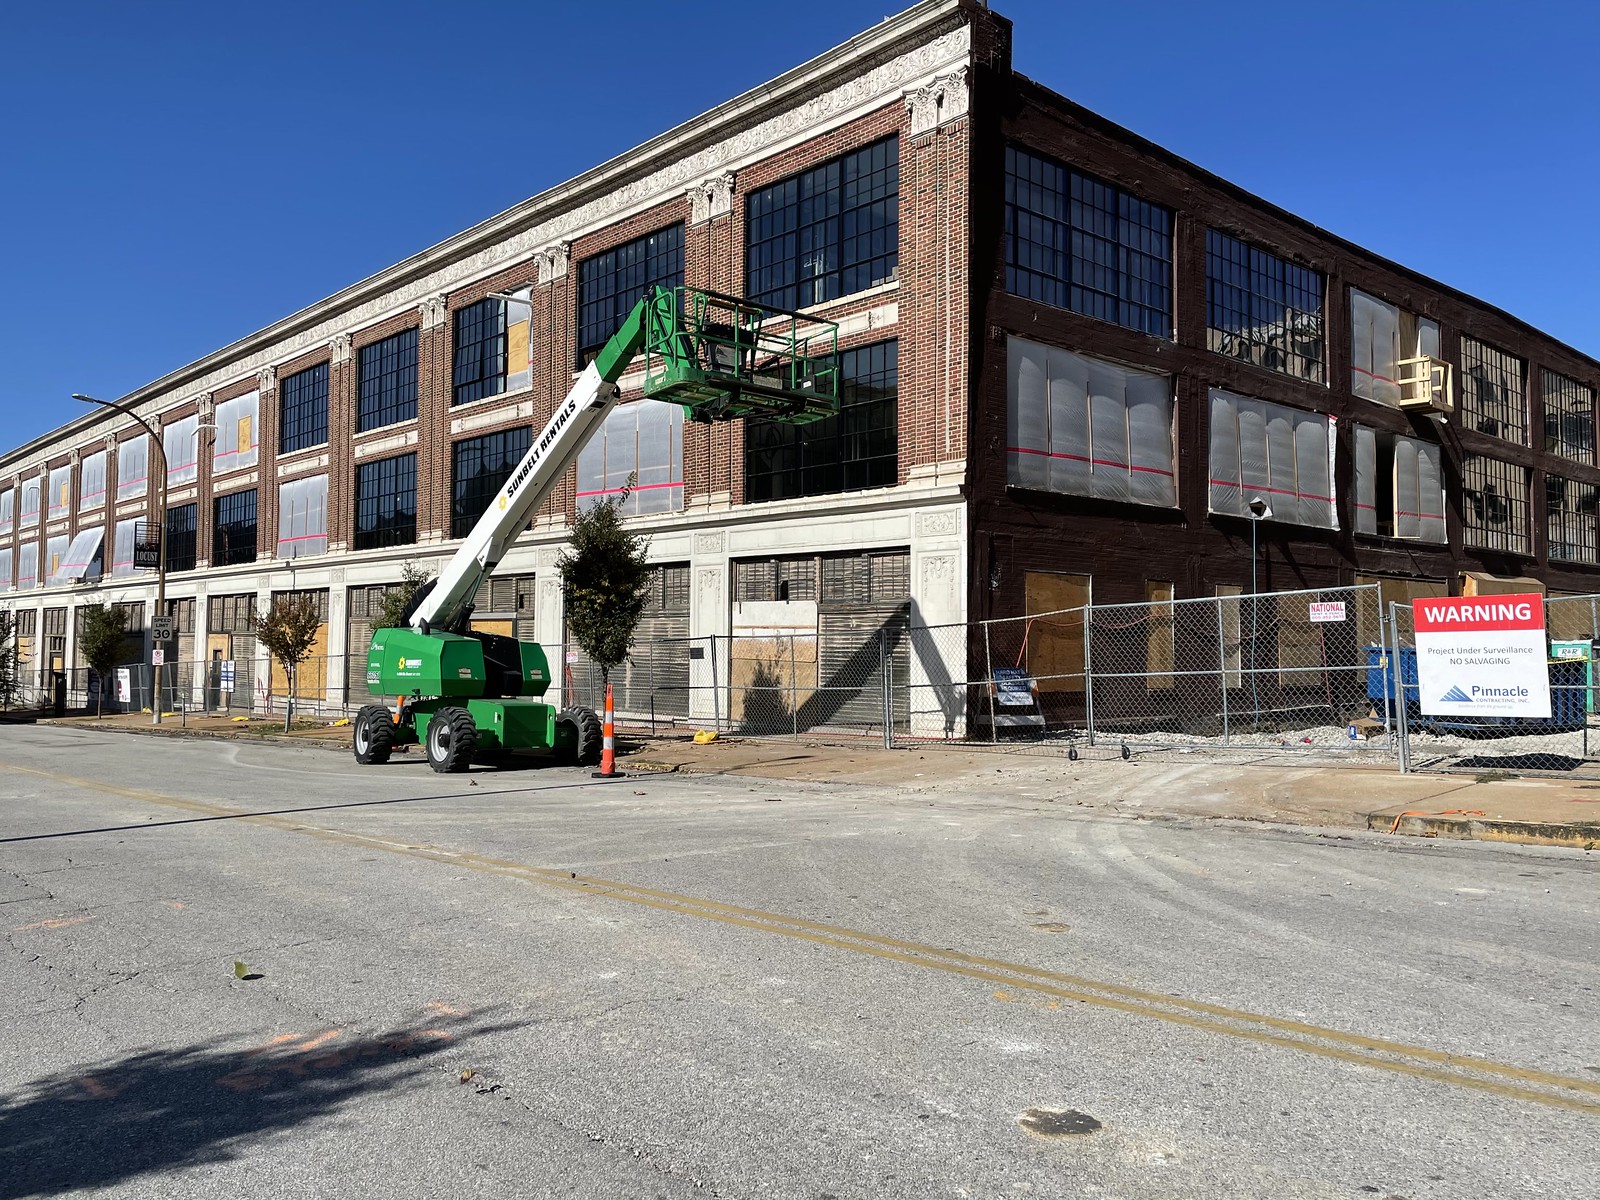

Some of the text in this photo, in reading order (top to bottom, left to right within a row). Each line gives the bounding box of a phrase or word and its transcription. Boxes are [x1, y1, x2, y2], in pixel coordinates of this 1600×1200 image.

[507, 400, 576, 498] SUNBELT RENTALS
[136, 551, 158, 562] LOCUST
[1311, 603, 1344, 612] NATIONAL
[1424, 603, 1531, 623] WARNING
[153, 629, 170, 639] 30
[1427, 646, 1533, 656] Project Under Surveillance
[1465, 657, 1511, 665] SALVAGING
[1472, 685, 1529, 697] Pinnacle
